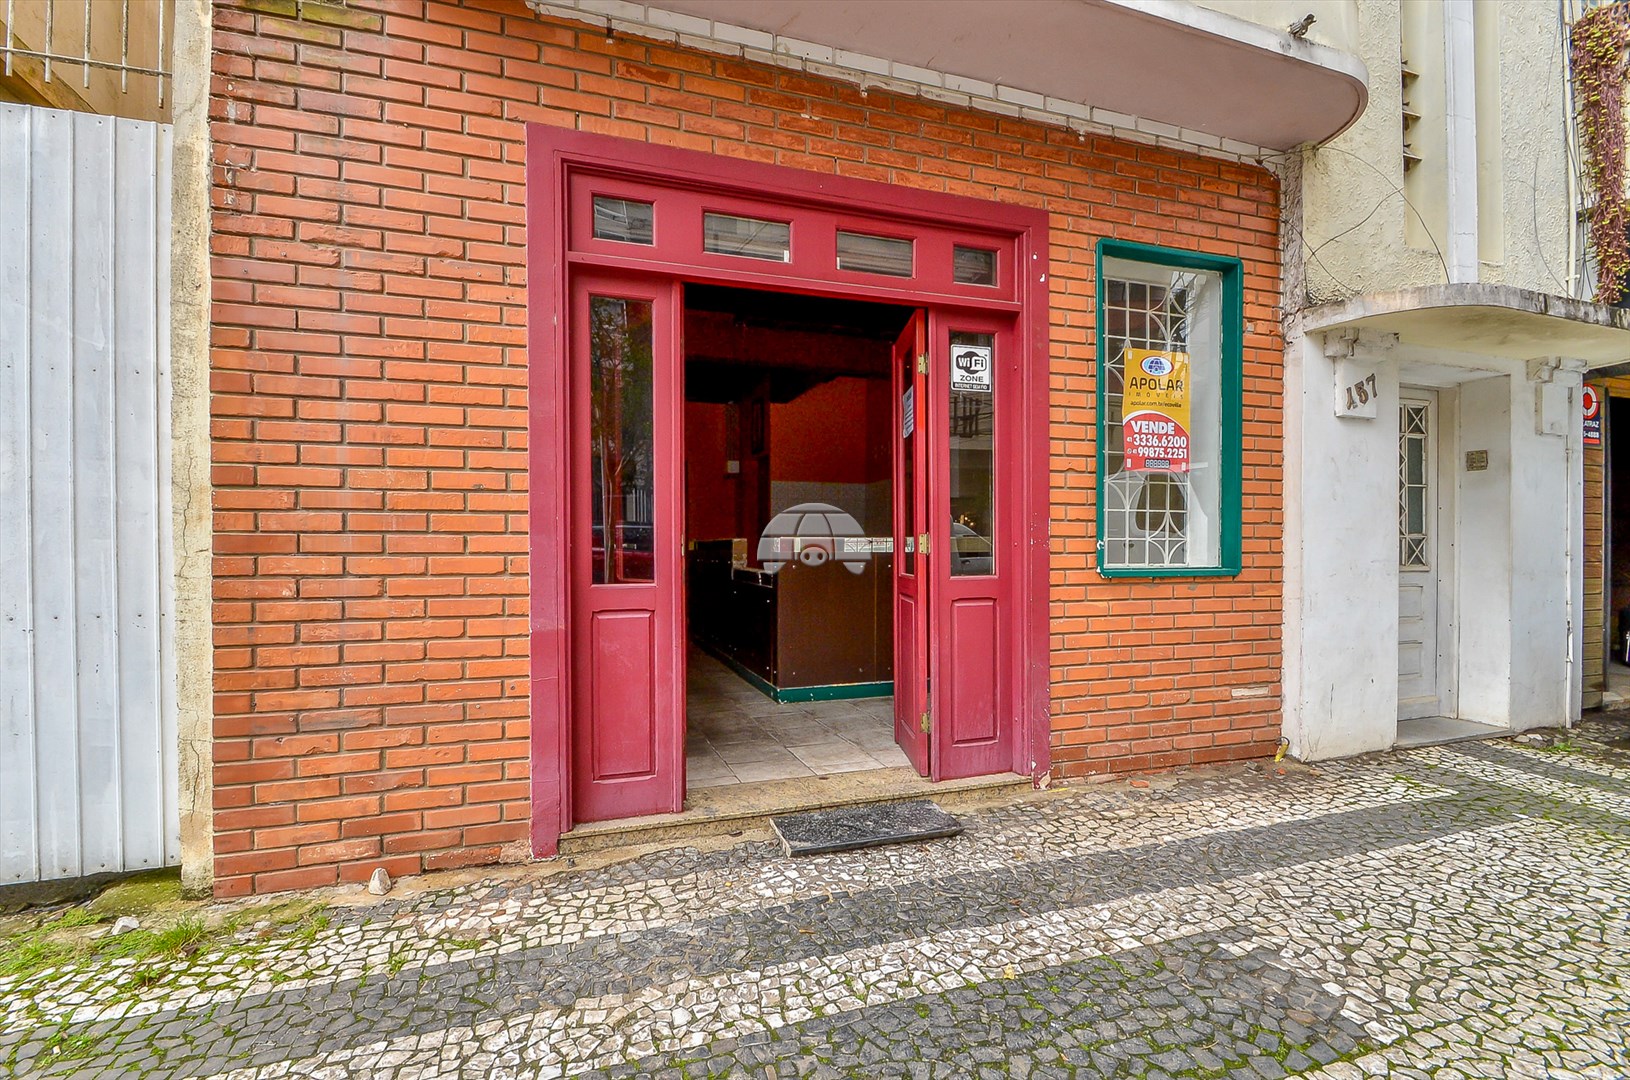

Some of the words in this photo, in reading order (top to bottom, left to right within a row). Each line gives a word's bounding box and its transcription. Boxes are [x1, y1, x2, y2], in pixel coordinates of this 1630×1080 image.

[958, 357, 984, 368] WiFi
[1130, 377, 1184, 392] APOLAR
[1346, 373, 1377, 410] 157
[1130, 420, 1175, 435] VENDE
[1583, 420, 1600, 428] ATRAZ
[1133, 434, 1187, 448] 3336.6200
[1137, 446, 1187, 459] 99875.2251
